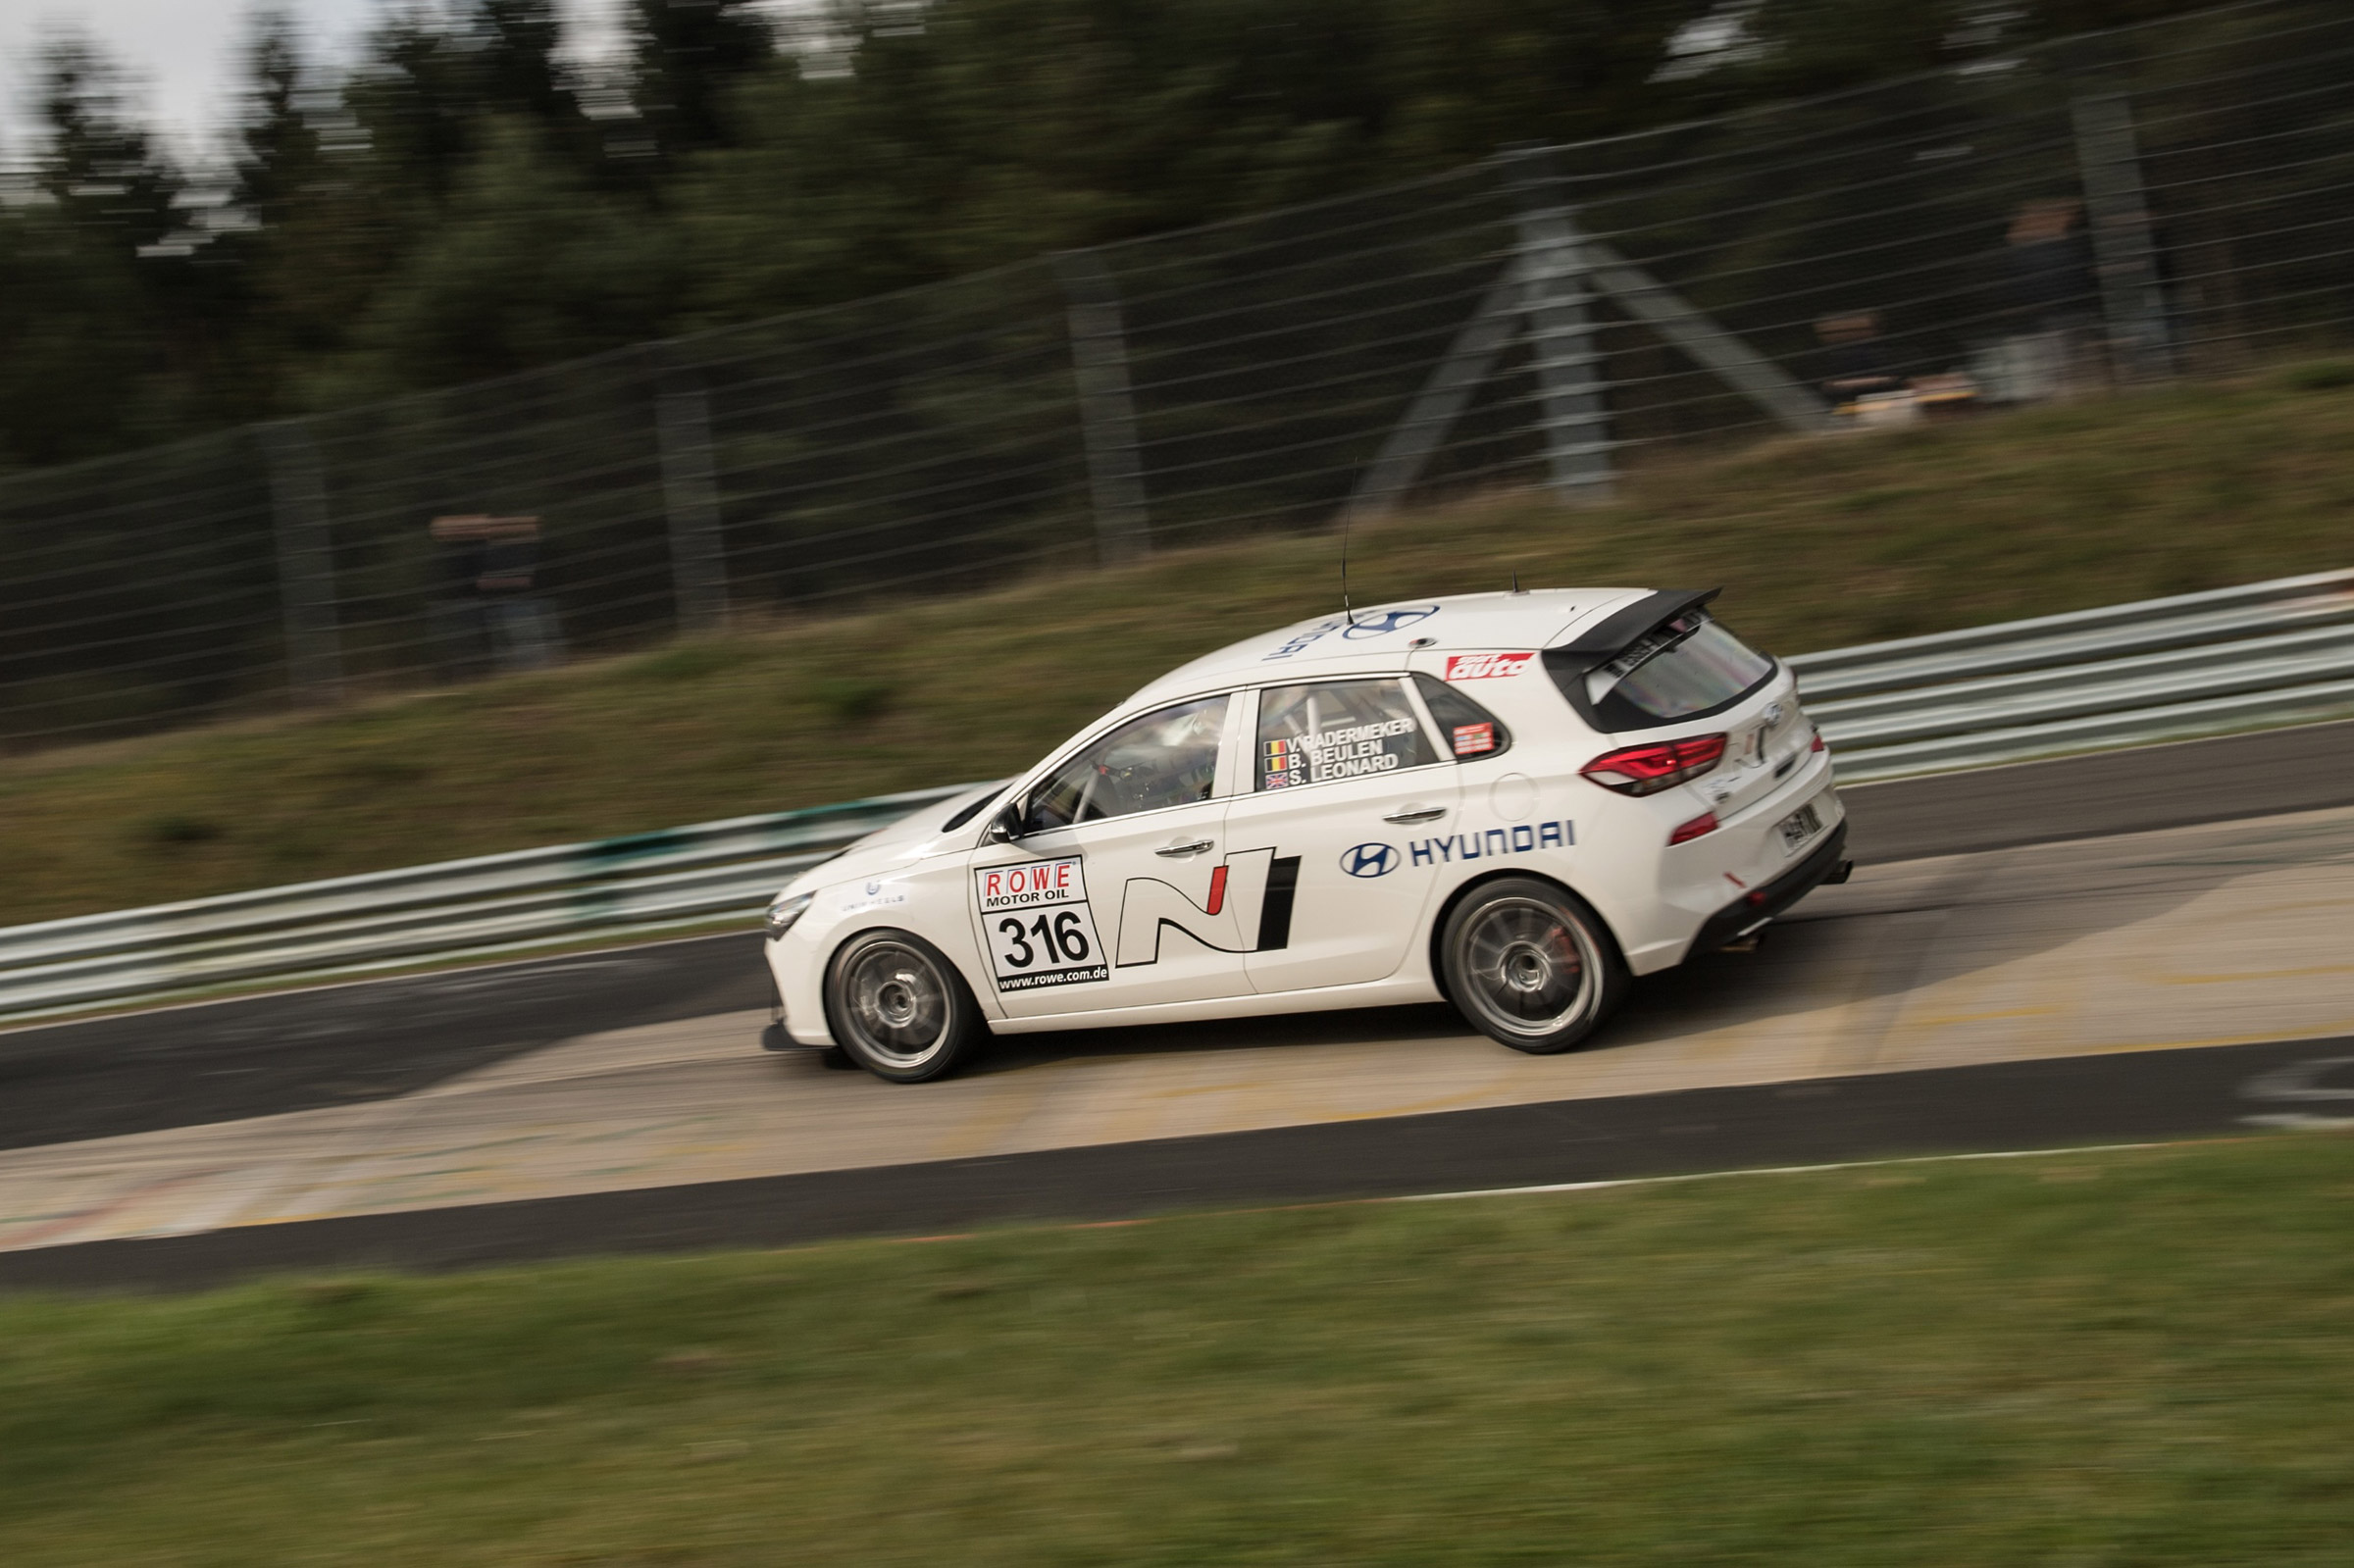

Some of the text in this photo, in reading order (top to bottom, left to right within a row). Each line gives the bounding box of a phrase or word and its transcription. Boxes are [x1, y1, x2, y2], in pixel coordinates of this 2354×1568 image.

[1449, 658, 1530, 679] auto
[1288, 738, 1384, 770] B. BEULEN
[1289, 753, 1400, 785] S. LEONARD
[1409, 819, 1577, 867] HYUNDAI
[984, 862, 1072, 897] ROWE
[986, 888, 1070, 908] MOTOR OIL
[998, 910, 1091, 969] 316
[998, 966, 1108, 990] www.rowe.com.de
